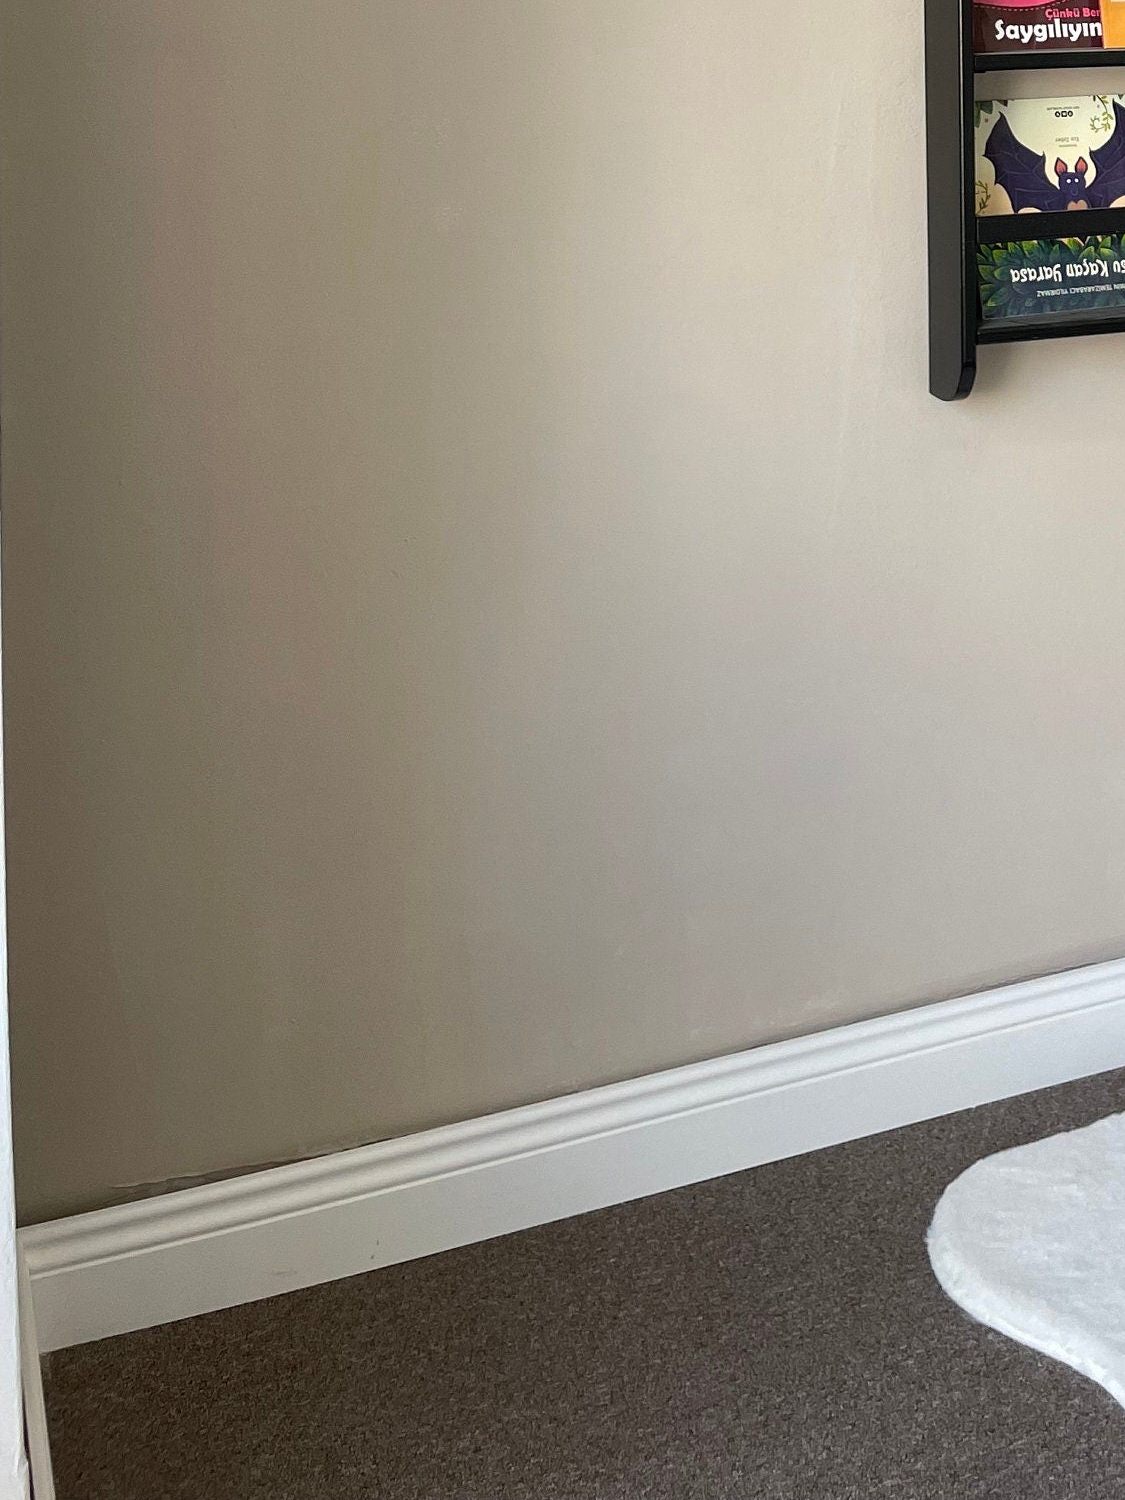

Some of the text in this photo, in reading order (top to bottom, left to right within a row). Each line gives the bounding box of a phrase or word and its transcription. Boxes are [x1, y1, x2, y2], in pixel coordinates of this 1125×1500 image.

[1045, 7, 1080, 20] Çünkü
[1010, 263, 1062, 283] Yarasa
[1066, 258, 1109, 278] Kaçan
